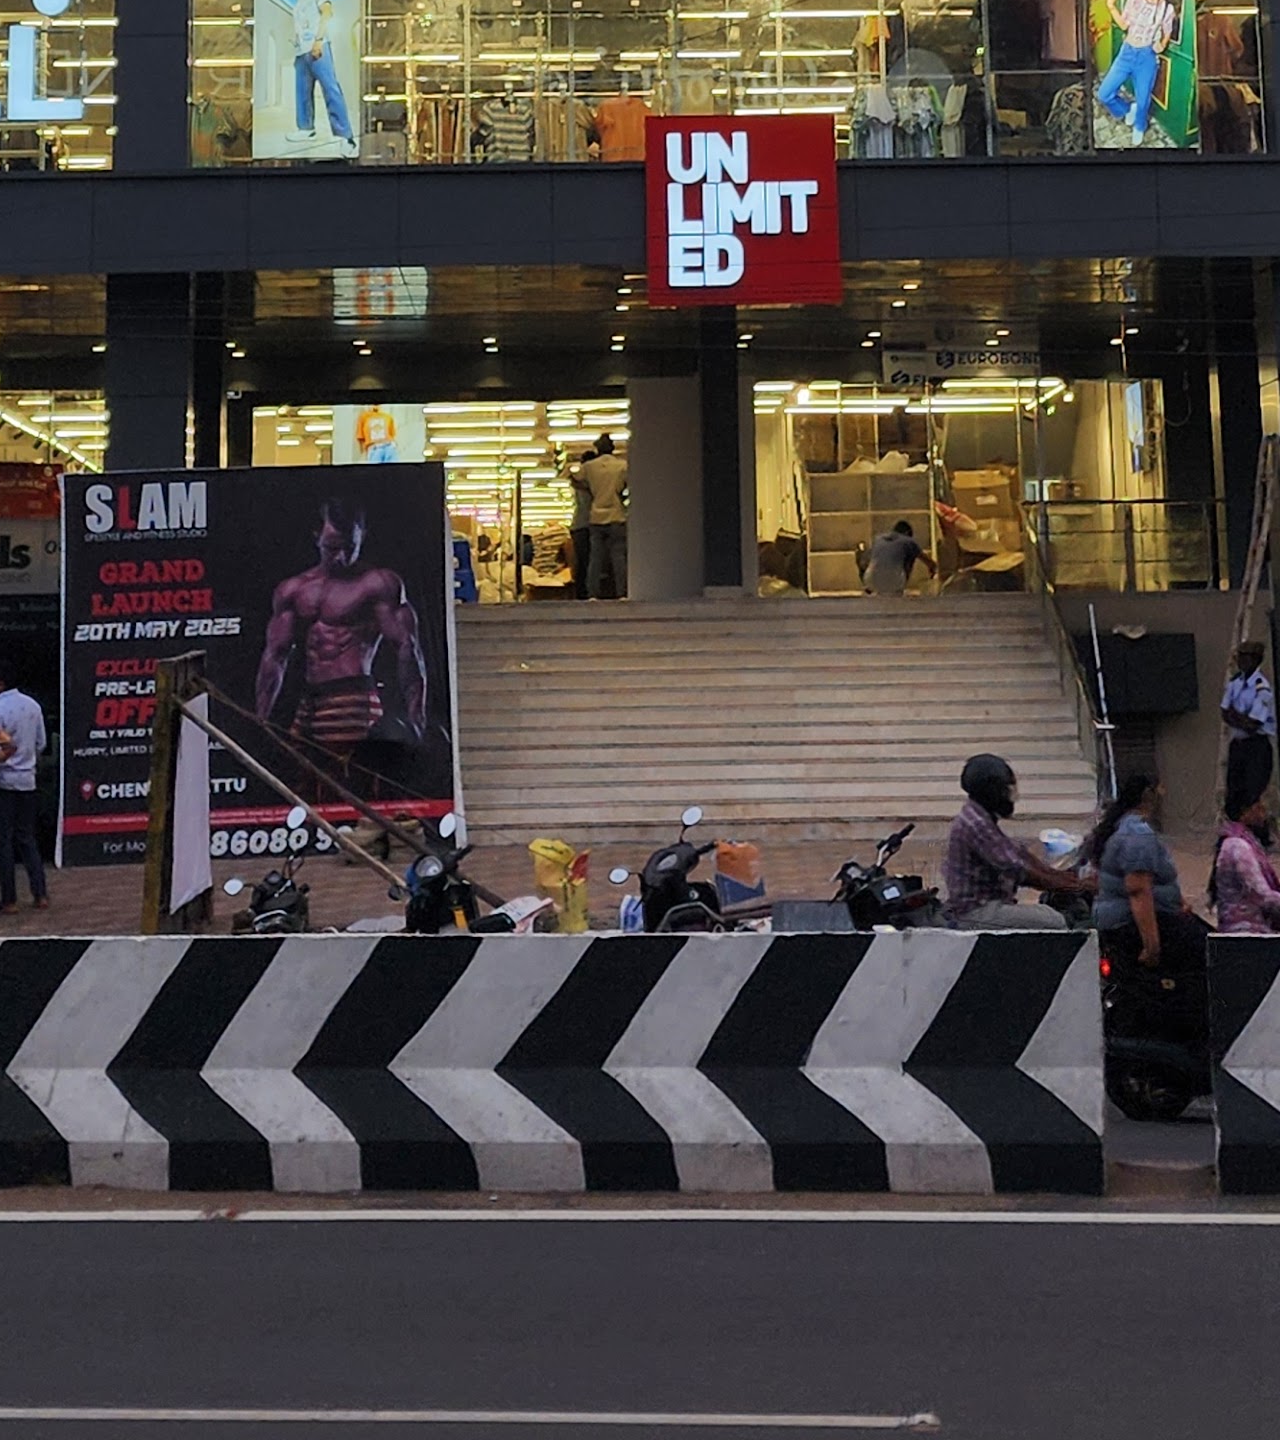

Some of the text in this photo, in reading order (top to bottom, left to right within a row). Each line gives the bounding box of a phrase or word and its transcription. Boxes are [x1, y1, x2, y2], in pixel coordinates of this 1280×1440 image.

[665, 131, 749, 185] UN
[667, 180, 818, 236] LIMIT
[668, 234, 745, 287] ED
[85, 481, 208, 534] SLAM
[99, 558, 205, 586] GRAND
[91, 587, 213, 617] LAUNCH
[74, 621, 130, 643] 20TH
[134, 620, 180, 641] MAY
[184, 616, 241, 638] 2025
